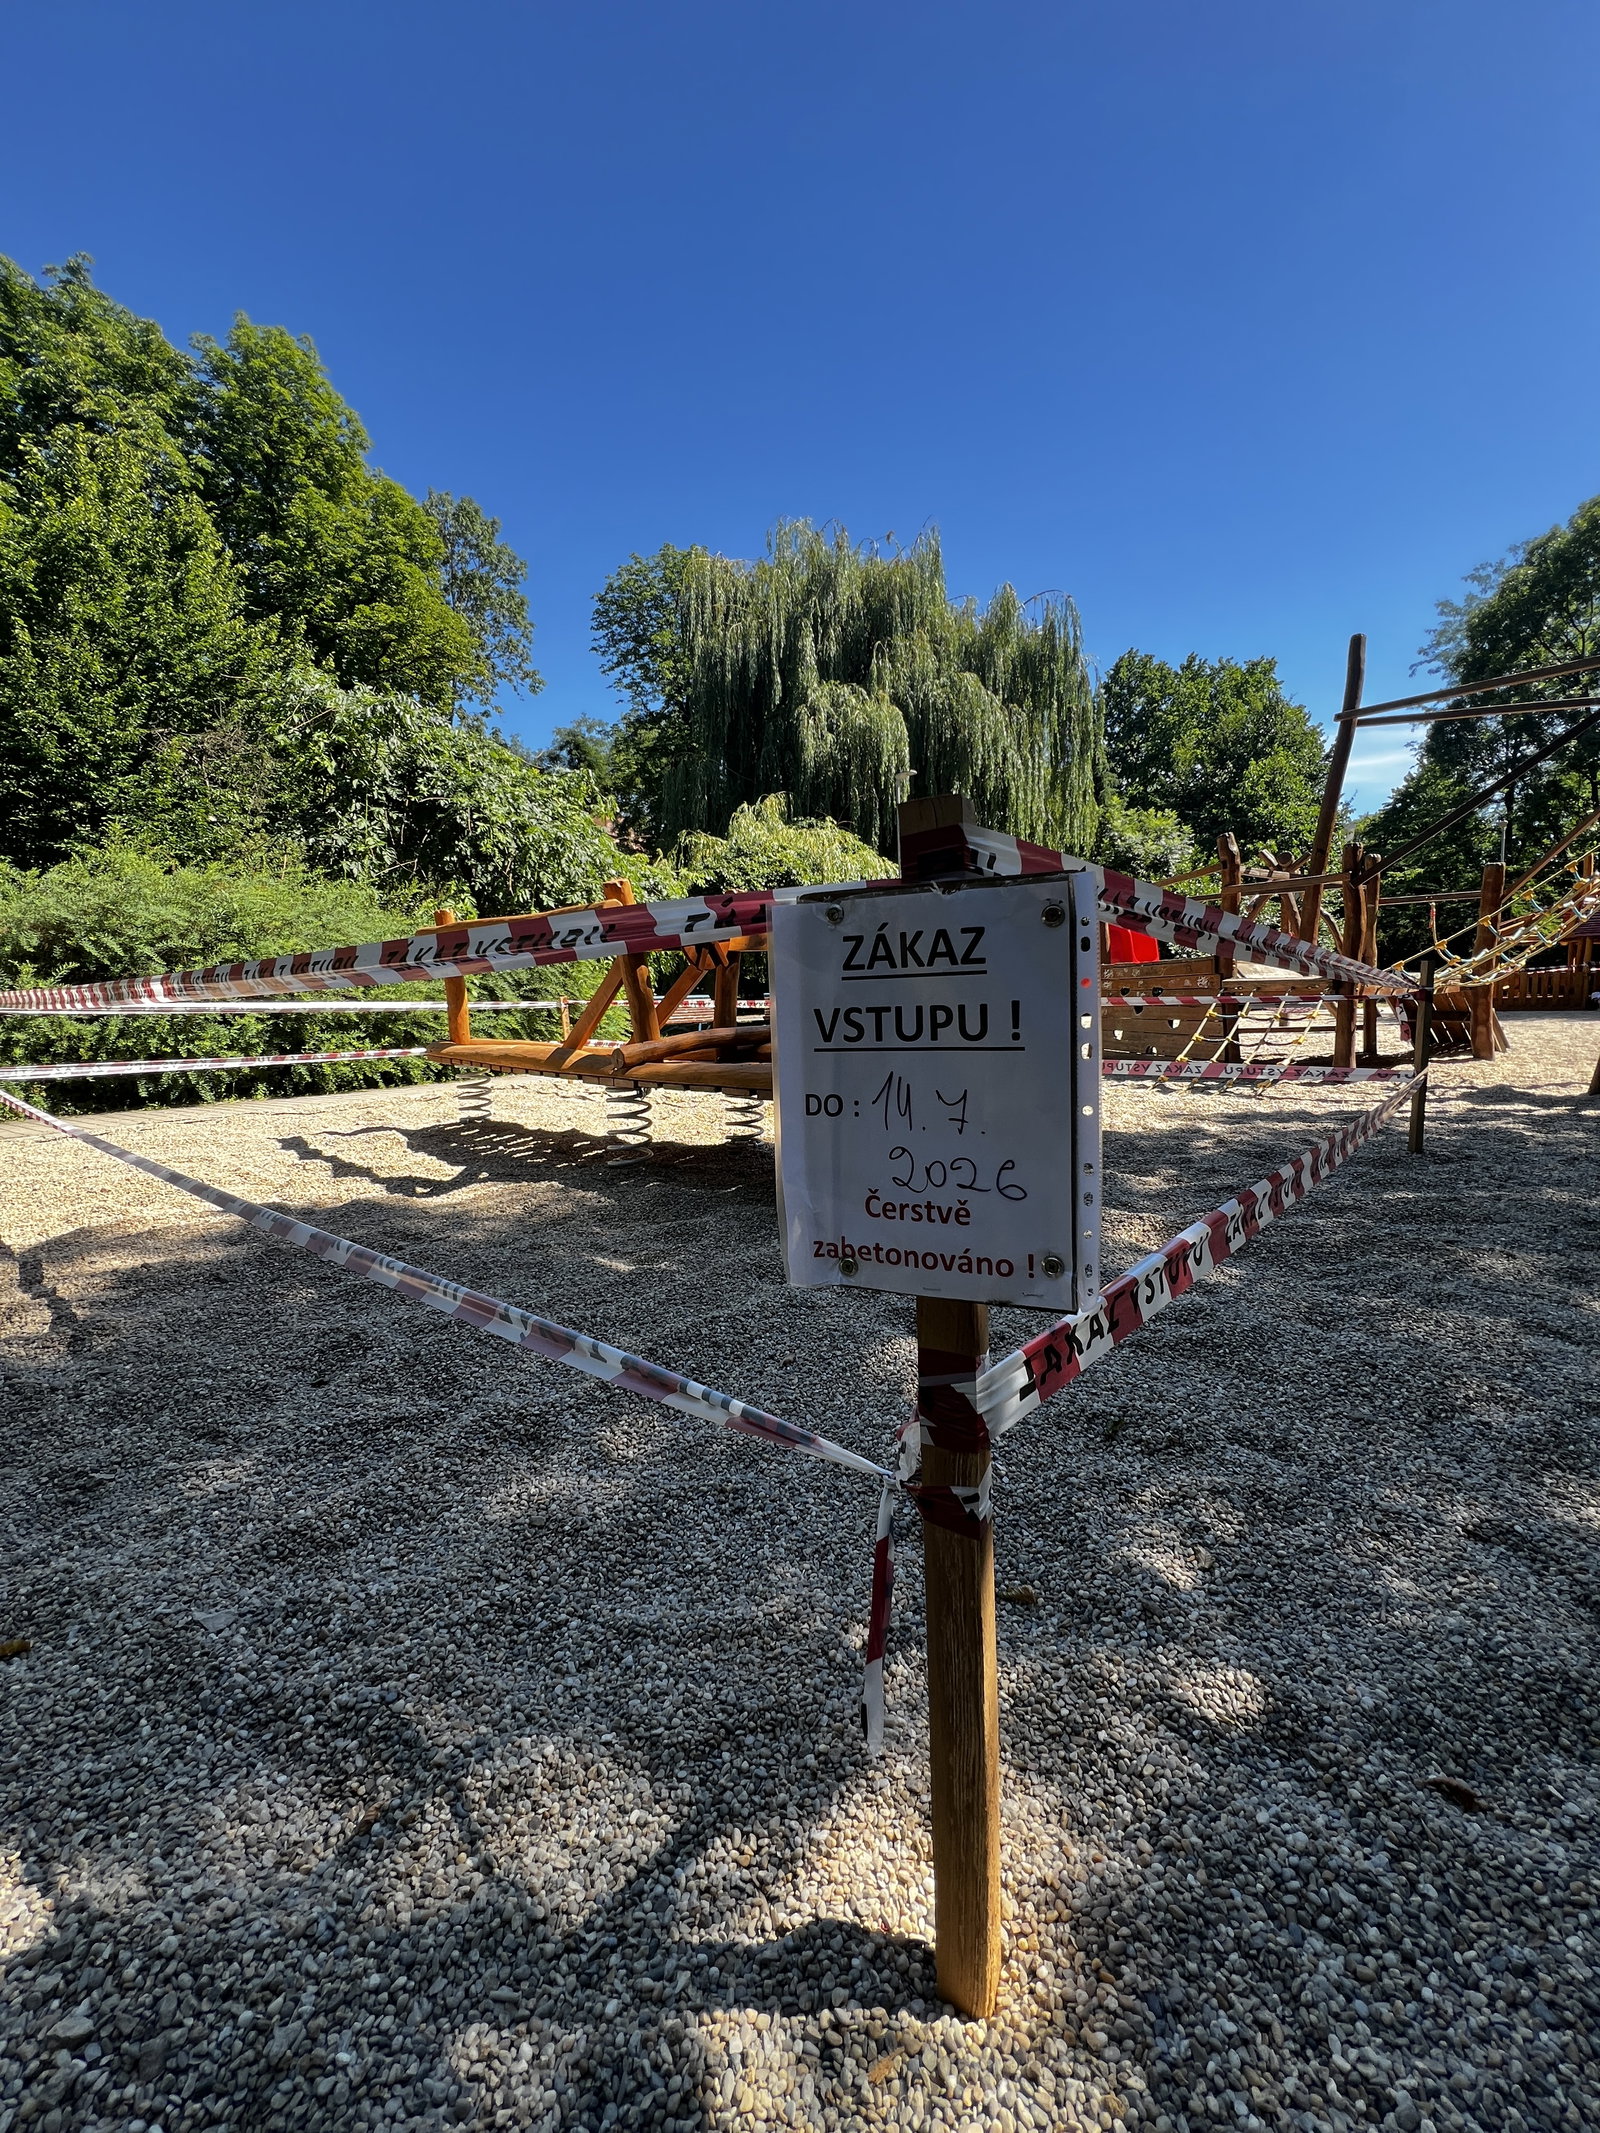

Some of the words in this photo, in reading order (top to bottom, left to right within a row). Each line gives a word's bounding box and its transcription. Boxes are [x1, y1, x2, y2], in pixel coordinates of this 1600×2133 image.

[842, 922, 987, 972] ZÁKAZ
[813, 1003, 988, 1043] VSTUPU
[888, 1146, 1028, 1200] 2026
[865, 1188, 971, 1226] Čerstvě
[813, 1236, 1014, 1278] zabetonováno
